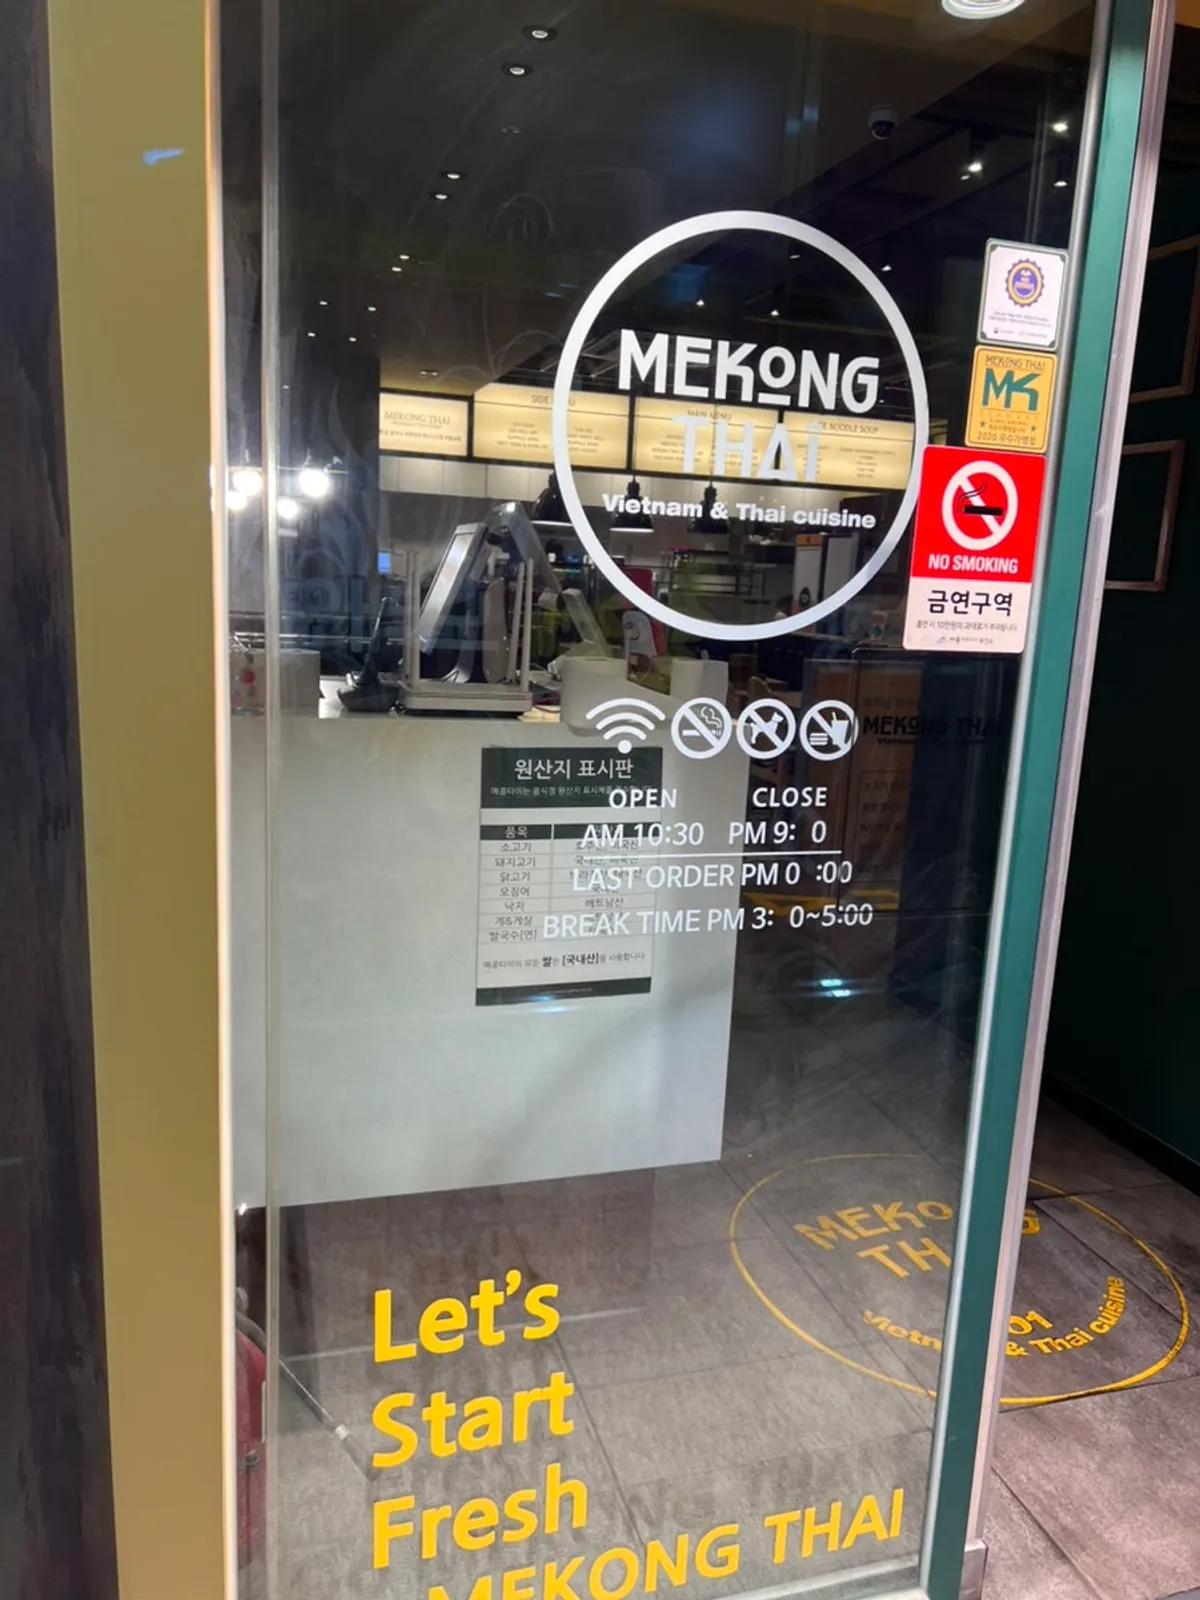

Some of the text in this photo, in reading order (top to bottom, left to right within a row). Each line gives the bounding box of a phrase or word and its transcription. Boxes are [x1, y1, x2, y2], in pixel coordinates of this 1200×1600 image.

[618, 328, 880, 413] MEKONG
[985, 355, 1046, 371] MEKONG THAI
[981, 367, 1042, 411] MK
[384, 411, 427, 425] MEKONG
[602, 493, 877, 530] Vietnam & Thai cuisine
[928, 553, 1019, 575] NO SMOKING
[927, 590, 1013, 617] 금연구역
[514, 758, 634, 780] 원산지 표시판
[608, 787, 677, 809] OPEN
[752, 786, 828, 808] CLOSE
[504, 826, 530, 839] 품목
[582, 823, 625, 849] AM
[634, 822, 704, 847] 10:30
[729, 821, 768, 845] PM
[501, 842, 532, 853] 소고기
[494, 856, 537, 868] 돼지고기
[499, 871, 531, 882] 닭고기
[572, 865, 641, 892] LAST
[646, 863, 734, 888] ORDER
[741, 862, 779, 886] PM
[499, 886, 531, 898] 오징어
[585, 896, 624, 908] 베트남산
[504, 901, 525, 912] 낙지
[542, 911, 630, 939] BREAK
[636, 909, 700, 934] TIME
[708, 906, 745, 931] PM
[373, 1269, 560, 1363] Let's
[1028, 1327, 1094, 1354] Thai
[1089, 1276, 1126, 1335] cuisine
[372, 1371, 575, 1468] Start
[373, 1463, 588, 1569] Fresh
[764, 1488, 904, 1565] THAI
